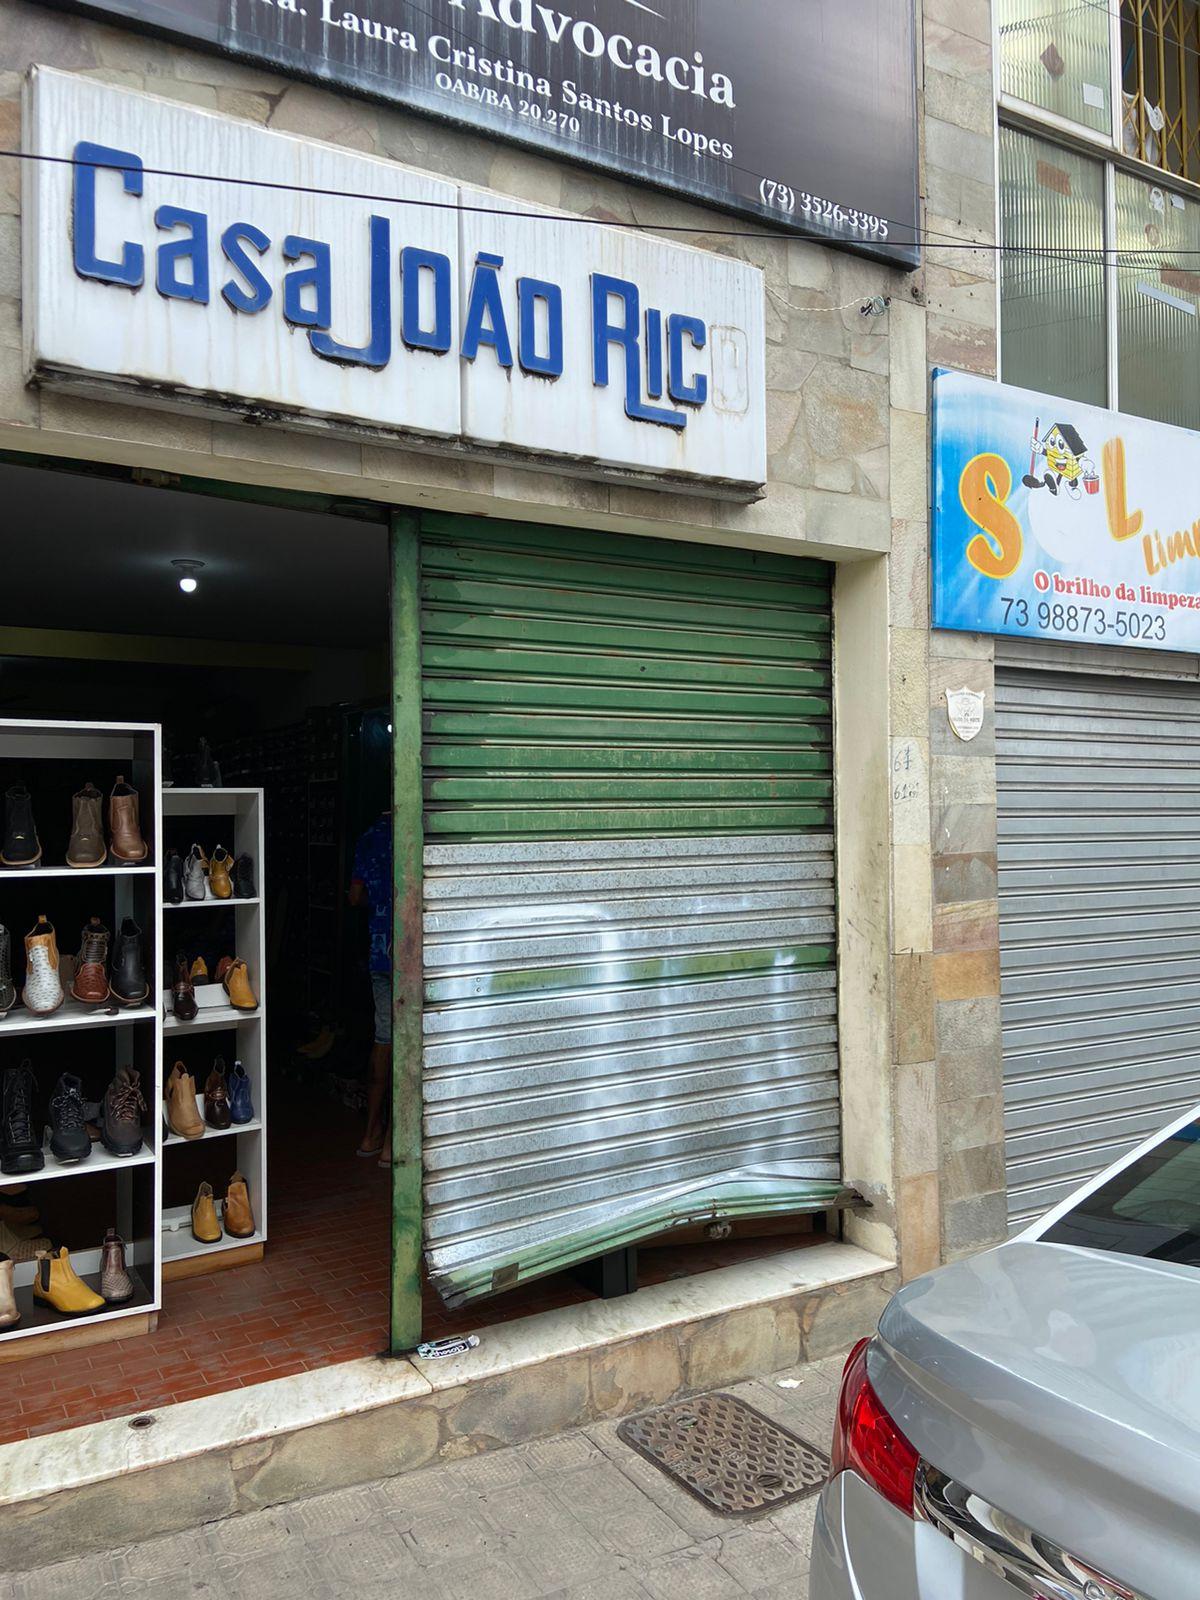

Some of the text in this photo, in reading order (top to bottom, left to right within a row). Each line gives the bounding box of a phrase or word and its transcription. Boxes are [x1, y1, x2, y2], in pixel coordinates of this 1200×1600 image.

[320, 0, 417, 52] Laura
[428, 35, 552, 98] Cristina
[562, 79, 653, 132] Santos
[661, 114, 733, 159] Lopes
[435, 73, 580, 133] OAB/BA 20.270
[759, 178, 889, 238] (73) 3526-3395
[1034, 572, 1049, 590] O
[1053, 574, 1111, 599] brilho
[1115, 583, 1136, 603] da
[1001, 597, 1166, 641] 73 98873-5023
